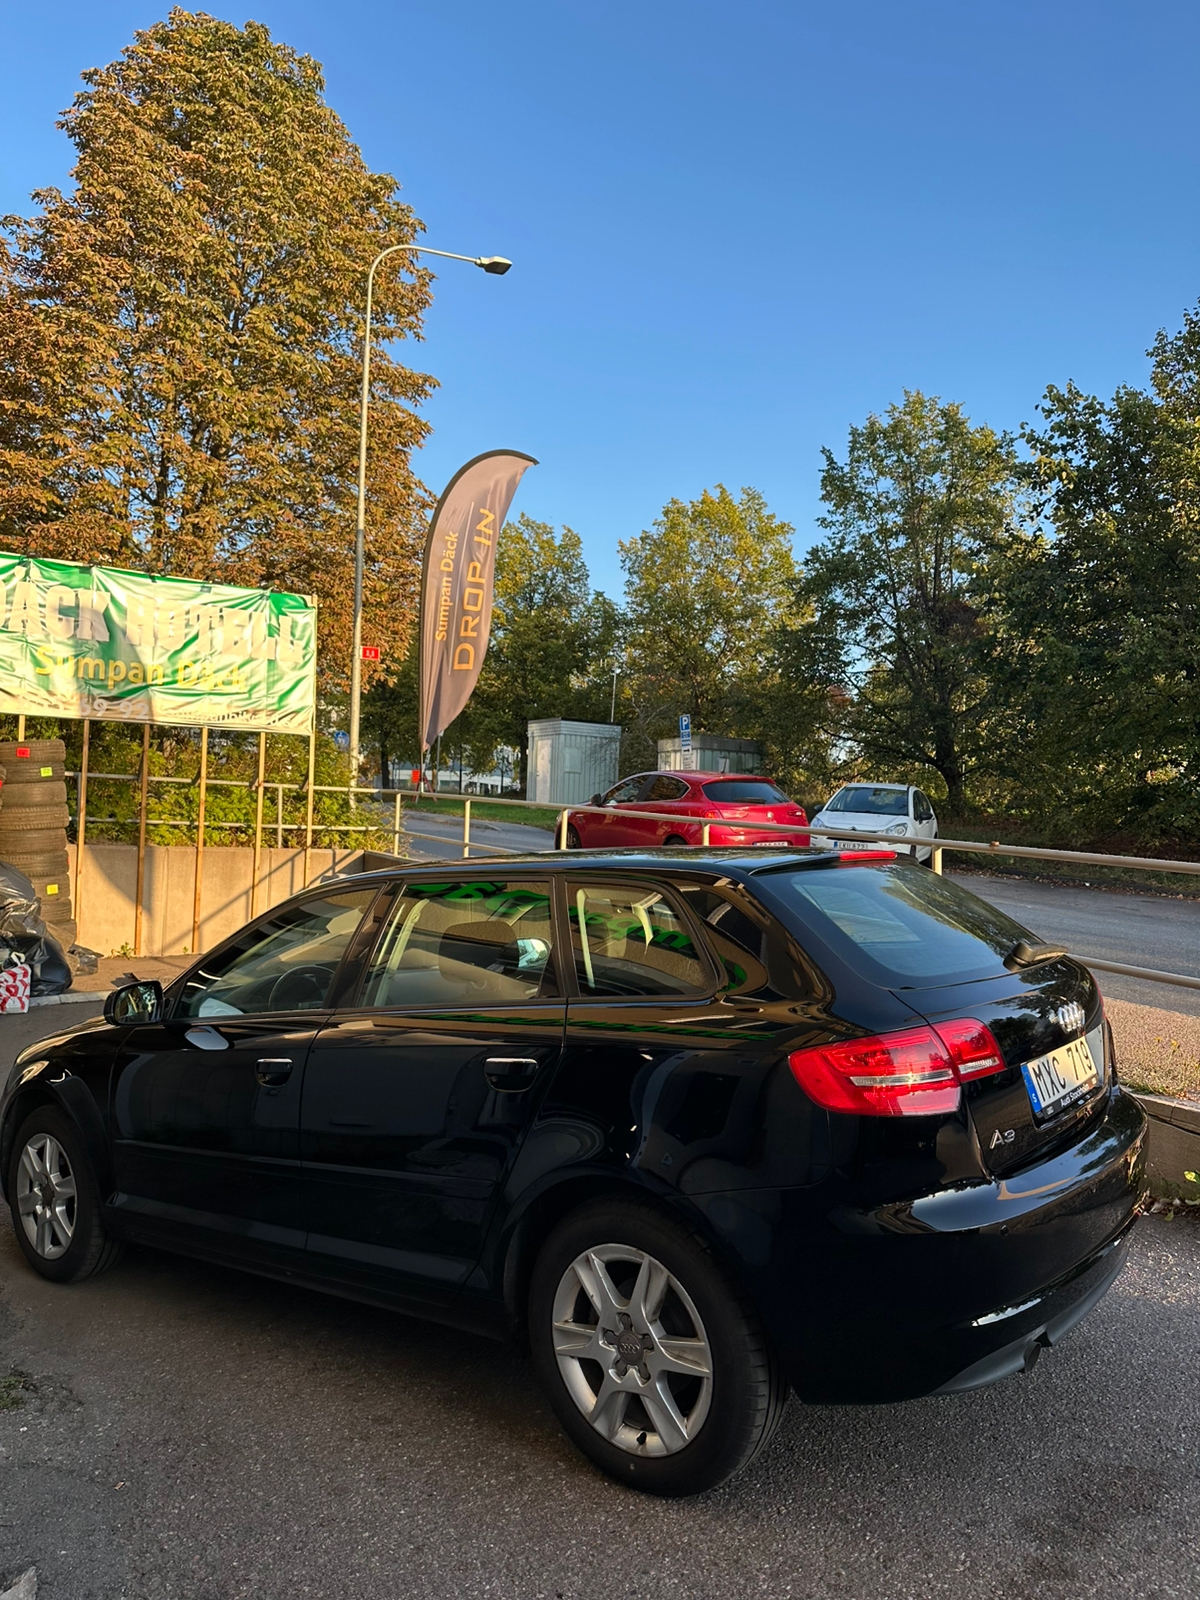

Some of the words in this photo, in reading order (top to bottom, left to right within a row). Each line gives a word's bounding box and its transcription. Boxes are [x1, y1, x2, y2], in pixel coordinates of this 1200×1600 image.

[440, 530, 459, 572] Däck
[0, 565, 111, 642] ÄCK
[435, 577, 453, 642] Sumpan
[453, 561, 486, 671] DROP
[34, 645, 164, 689] Sumpan
[1032, 1056, 1067, 1102] MXC
[1067, 1040, 1093, 1081] 719
[989, 1128, 1016, 1149] A3
